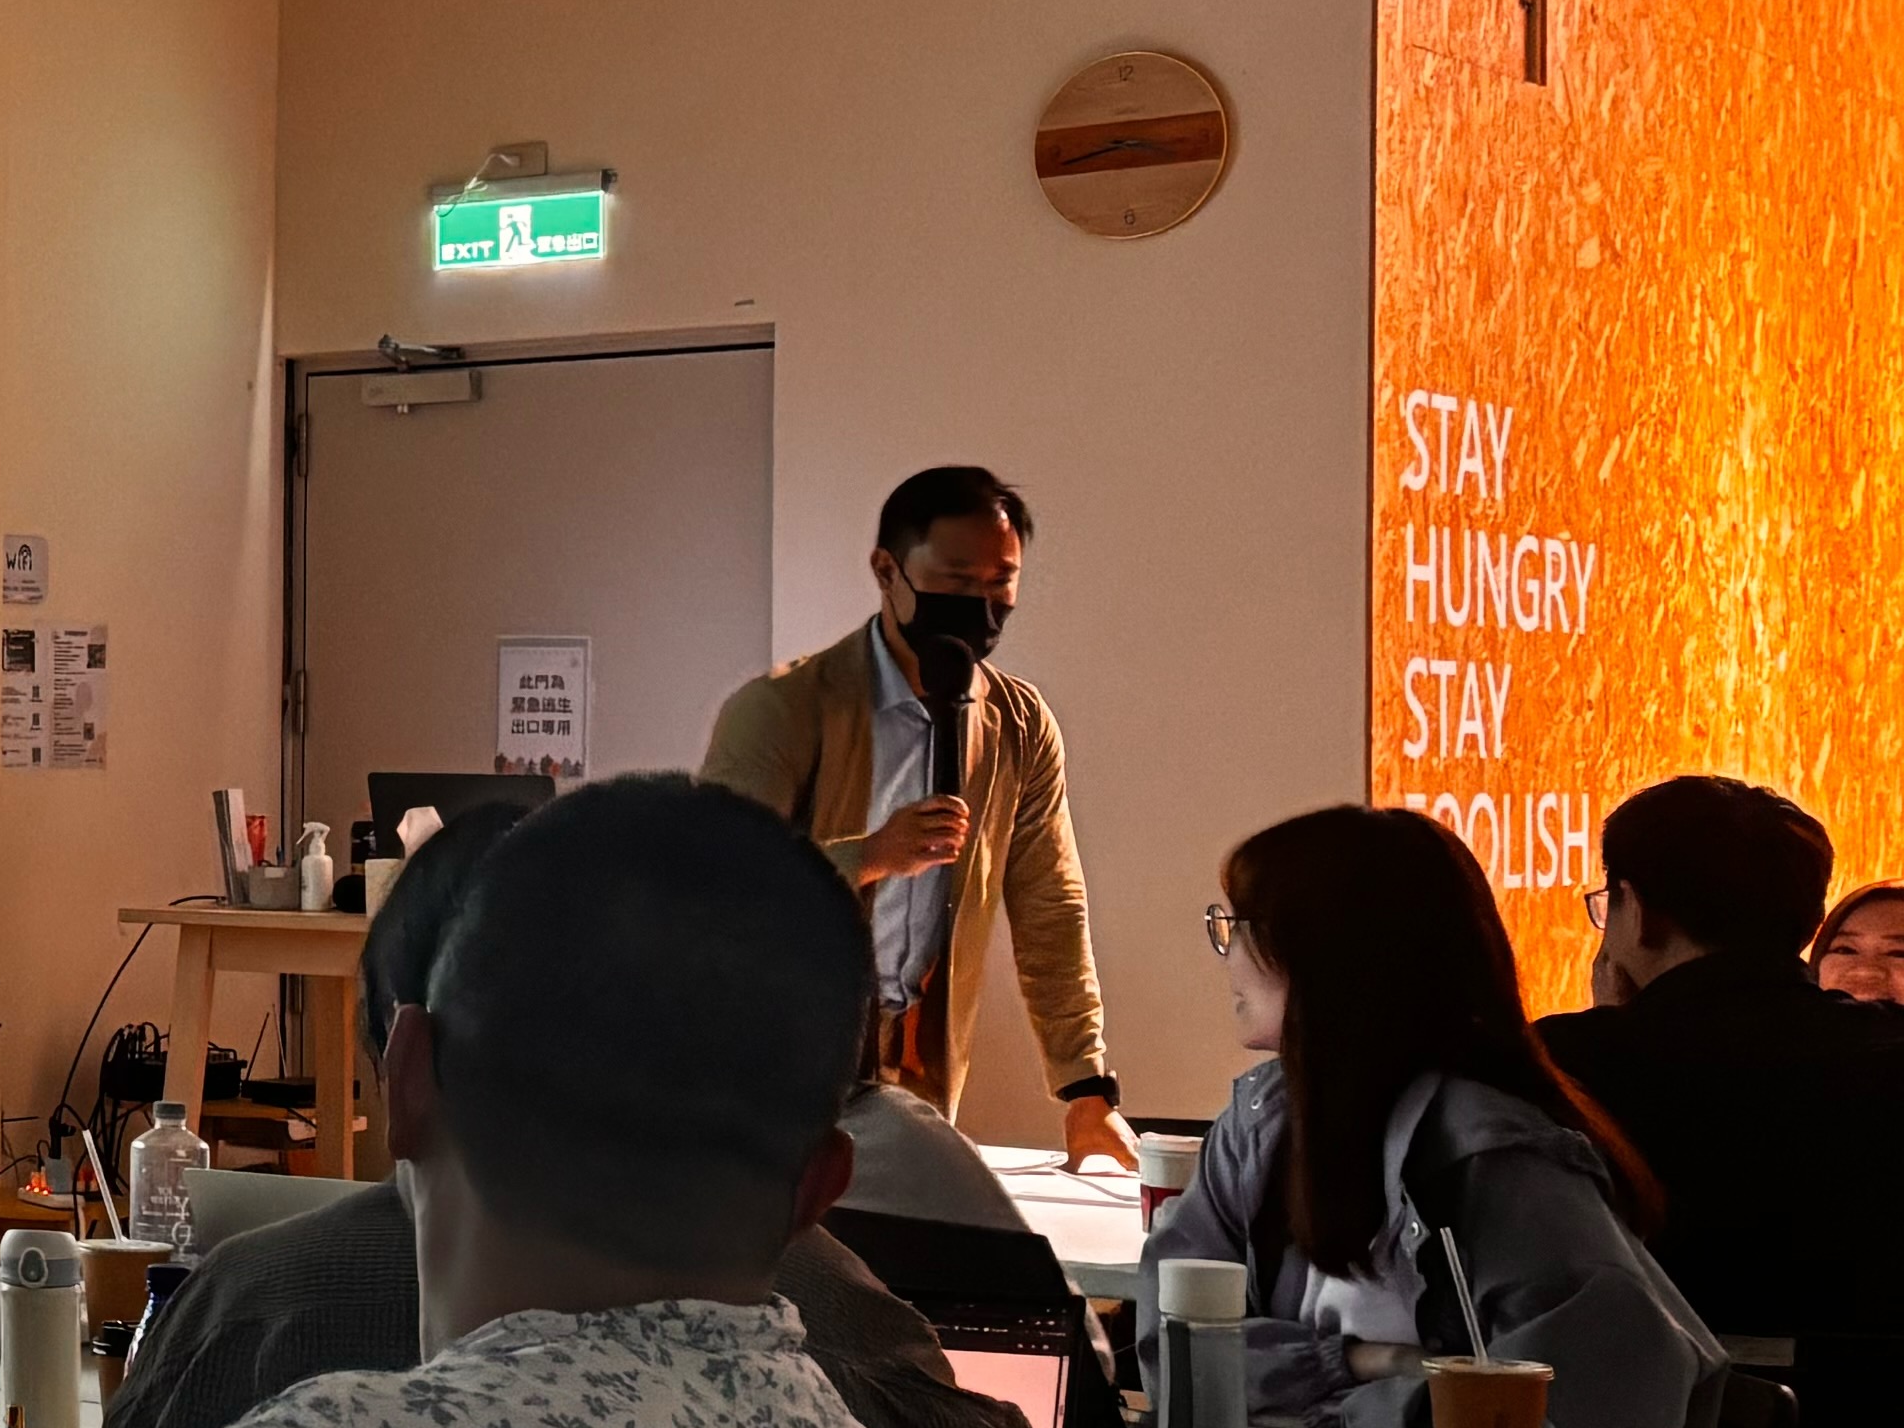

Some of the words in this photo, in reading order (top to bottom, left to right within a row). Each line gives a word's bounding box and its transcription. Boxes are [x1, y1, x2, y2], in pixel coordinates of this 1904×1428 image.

[1118, 64, 1134, 82] 12
[441, 240, 495, 261] EXIT
[1400, 389, 1514, 501] STAY
[1405, 522, 1597, 635] HUNGRY
[1402, 656, 1513, 760] STAY
[1404, 791, 1591, 890] OLISH
